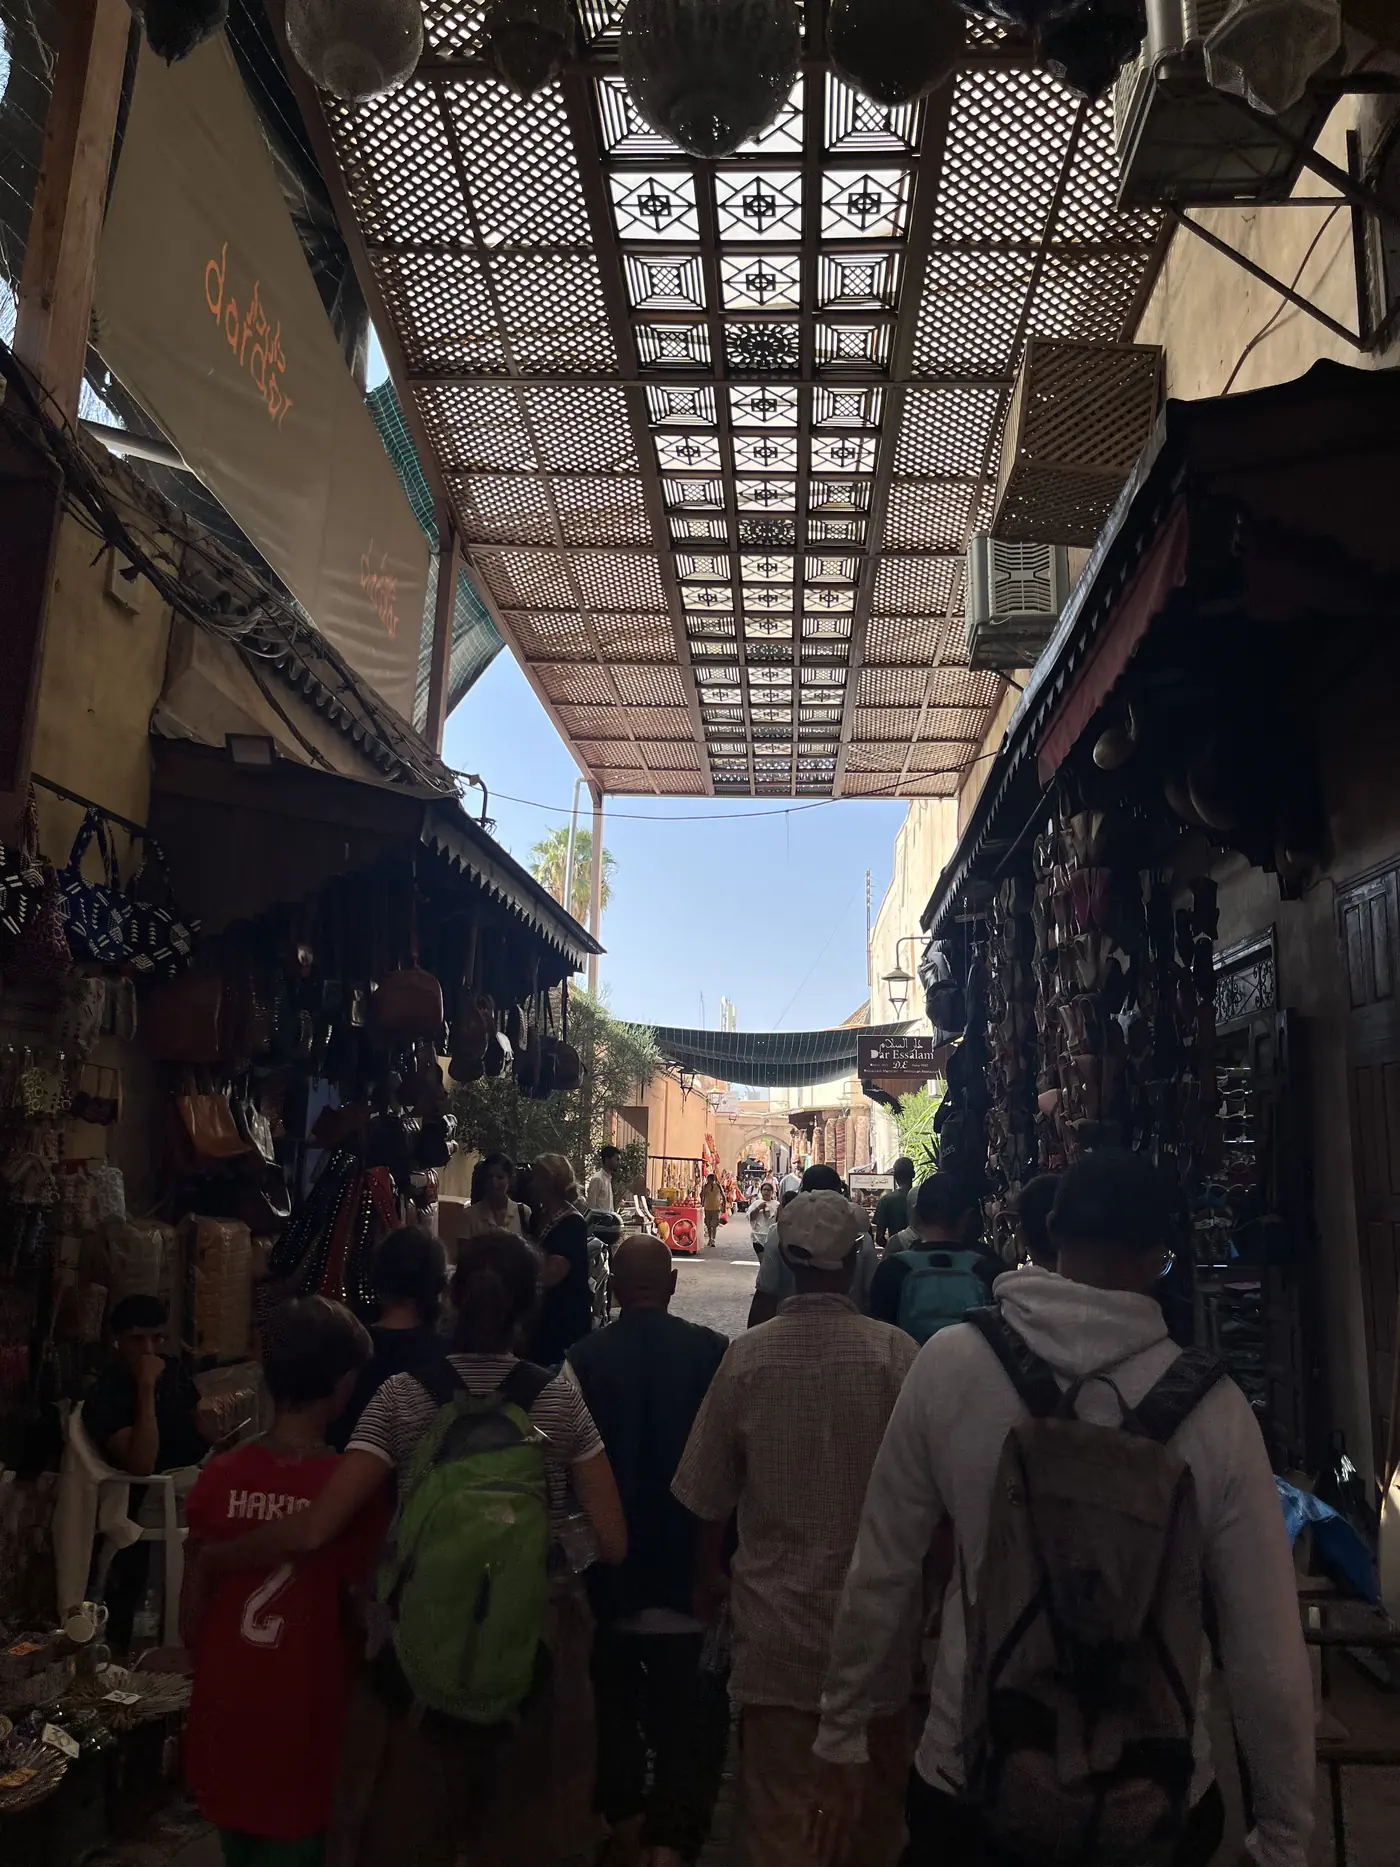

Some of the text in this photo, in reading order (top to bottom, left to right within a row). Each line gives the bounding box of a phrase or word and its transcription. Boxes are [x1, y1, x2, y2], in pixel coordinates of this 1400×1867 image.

[879, 1038, 908, 1053] السلام
[870, 1049, 934, 1060] Dar Essalam
